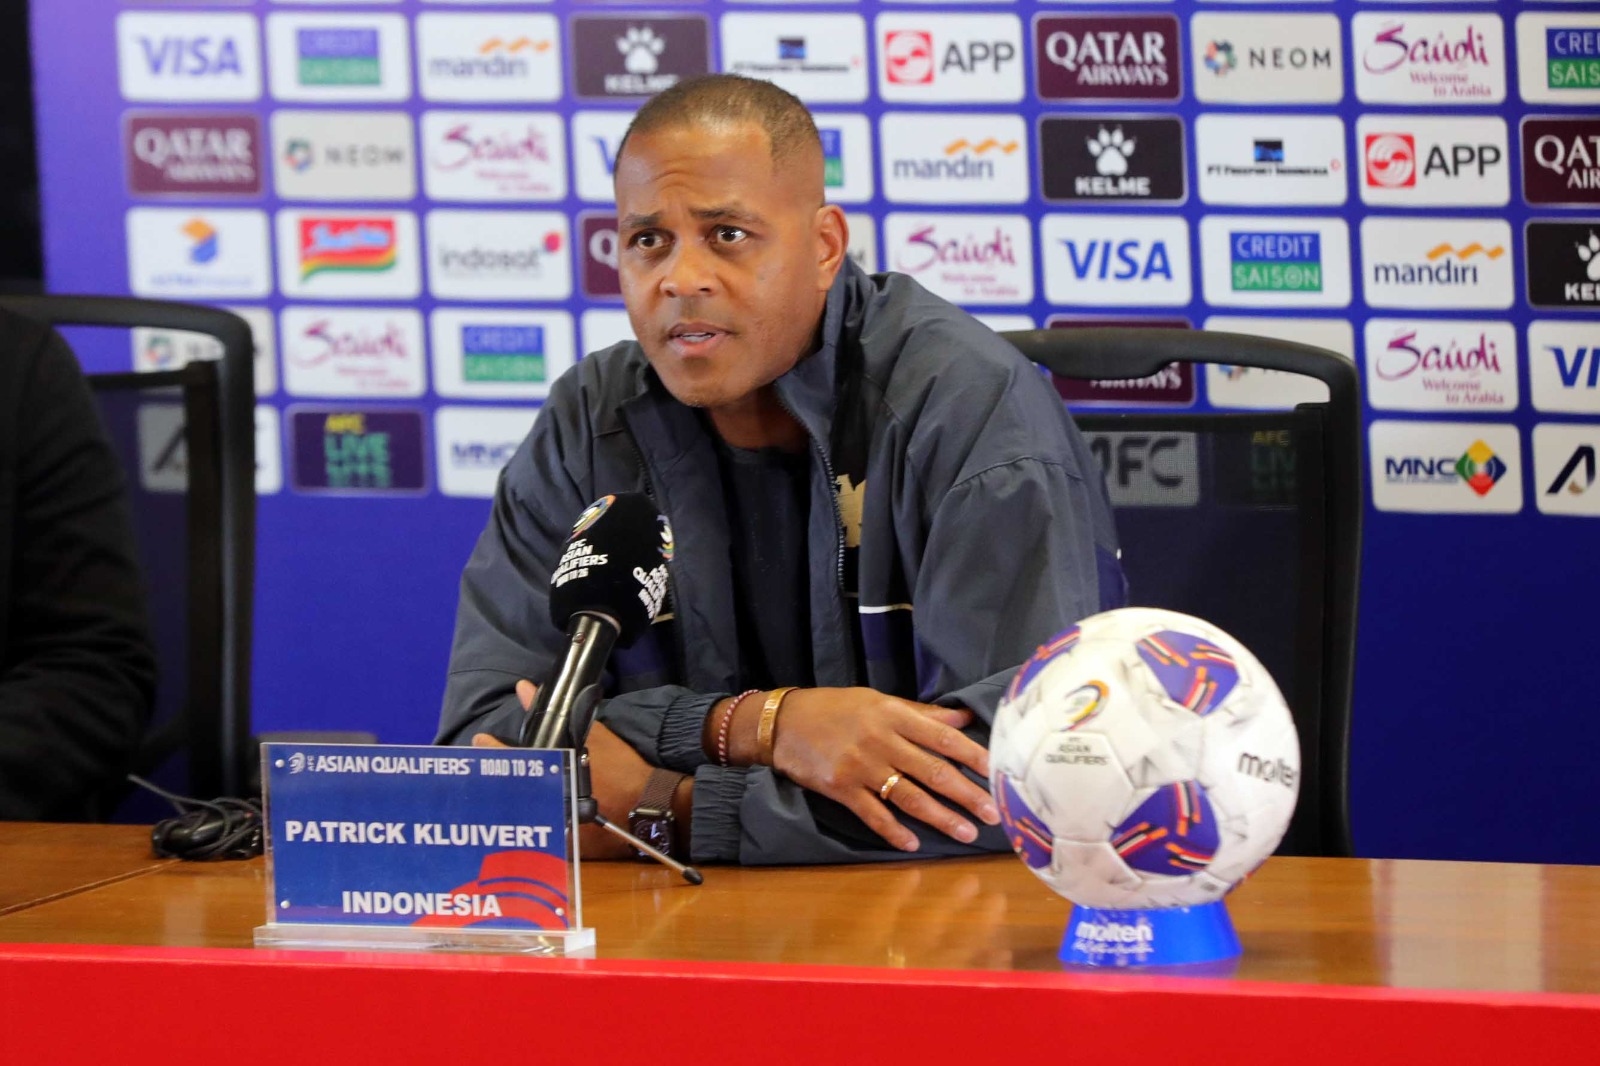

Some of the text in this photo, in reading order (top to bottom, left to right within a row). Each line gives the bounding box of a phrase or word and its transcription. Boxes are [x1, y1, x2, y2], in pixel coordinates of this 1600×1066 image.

[138, 37, 243, 77] VISA
[941, 41, 1015, 73] APP
[1045, 31, 1166, 71] QATAR
[1249, 48, 1331, 69] NEOM
[1077, 65, 1168, 86] AIRWAYS
[1410, 71, 1469, 84] Welcome
[1433, 84, 1492, 97] to Arabia
[324, 146, 405, 167] NEOM
[893, 155, 994, 179] mandiri
[1423, 144, 1501, 178] APP
[1075, 177, 1151, 196] KELME
[441, 243, 540, 269] indosat
[1236, 235, 1313, 258] CREDIT
[1058, 238, 1173, 281] VISA
[1234, 264, 1319, 289] SAISON
[1374, 259, 1478, 285] mandiri
[1423, 378, 1480, 391] Welcome
[1464, 391, 1504, 404] Arabia
[1385, 458, 1459, 476] MNC
[315, 755, 544, 777] ASIAN QUALIFIERS ROAD TO 26
[1238, 752, 1299, 789] molte
[285, 821, 553, 848] PATRICK KLUIVERT
[342, 890, 502, 917] INDONESIA
[1076, 921, 1154, 943] molten
